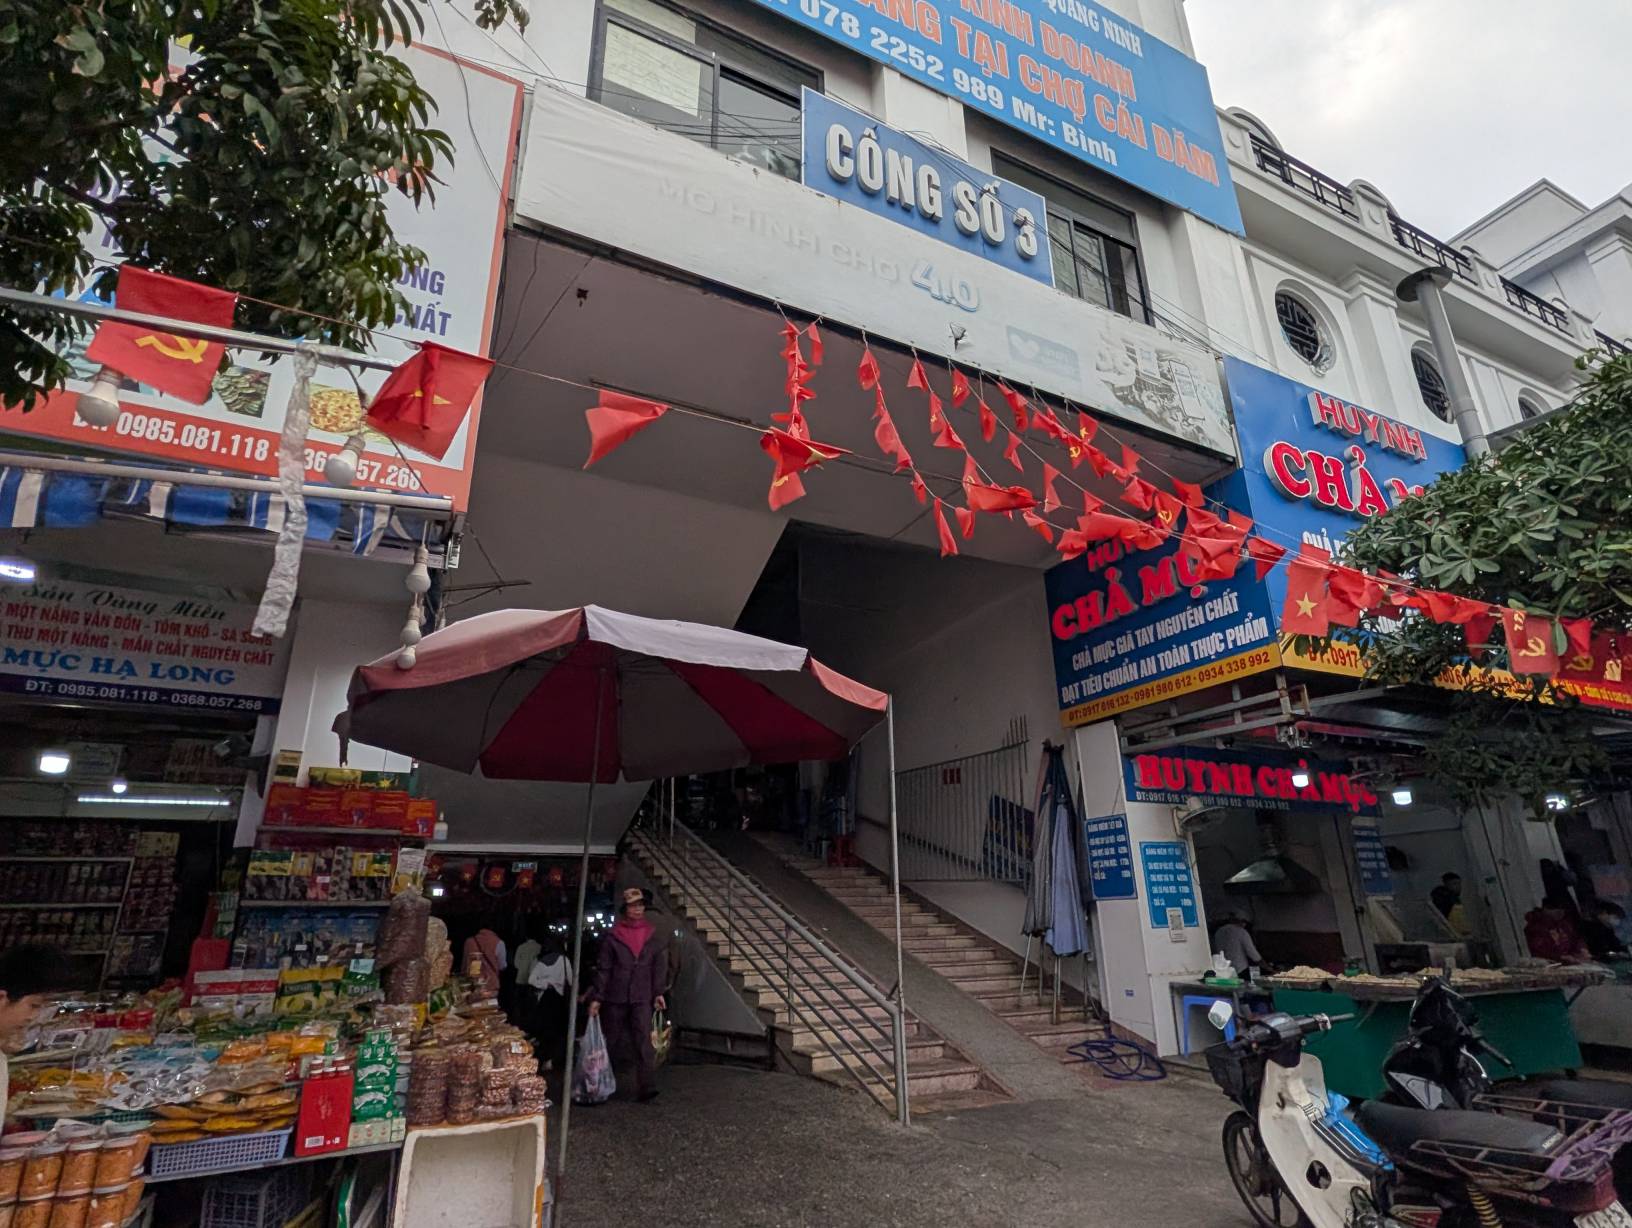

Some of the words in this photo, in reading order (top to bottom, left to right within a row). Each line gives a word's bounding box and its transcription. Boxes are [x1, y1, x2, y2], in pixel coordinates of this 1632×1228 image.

[961, 0, 1035, 47] INH
[1040, 20, 1136, 101] DOANH
[1102, 16, 1143, 57] NINH
[801, 0, 860, 39] 078
[870, 27, 945, 82] 2252
[953, 68, 1004, 110] 989
[1011, 96, 1056, 136] Mr:
[1062, 121, 1119, 167] Bình
[951, 16, 1009, 78] TẠI
[1018, 54, 1086, 124] CHỢ
[1093, 93, 1148, 149] CÁI
[953, 179, 1006, 246] SỐ
[1012, 207, 1038, 260] 3
[116, 412, 270, 461] 0985.081.118
[1263, 441, 1389, 517] CHẢ
[1052, 567, 1138, 640] CHẢ
[1072, 645, 1093, 671] CHẢ
[1134, 624, 1155, 648] TAY
[1155, 605, 1205, 640] NGUYÊN
[1205, 588, 1239, 622] CHẤT
[2, 647, 81, 672] MỰC
[90, 656, 137, 680] HẠ
[150, 662, 235, 685] LONG
[1140, 655, 1157, 678] AN
[1157, 644, 1190, 672] TOÀN
[1191, 632, 1224, 659] THỰC
[1226, 612, 1269, 647] PHẨM
[1198, 666, 1225, 682] 0934
[1227, 658, 1247, 674] 338
[1248, 652, 1271, 667] 992
